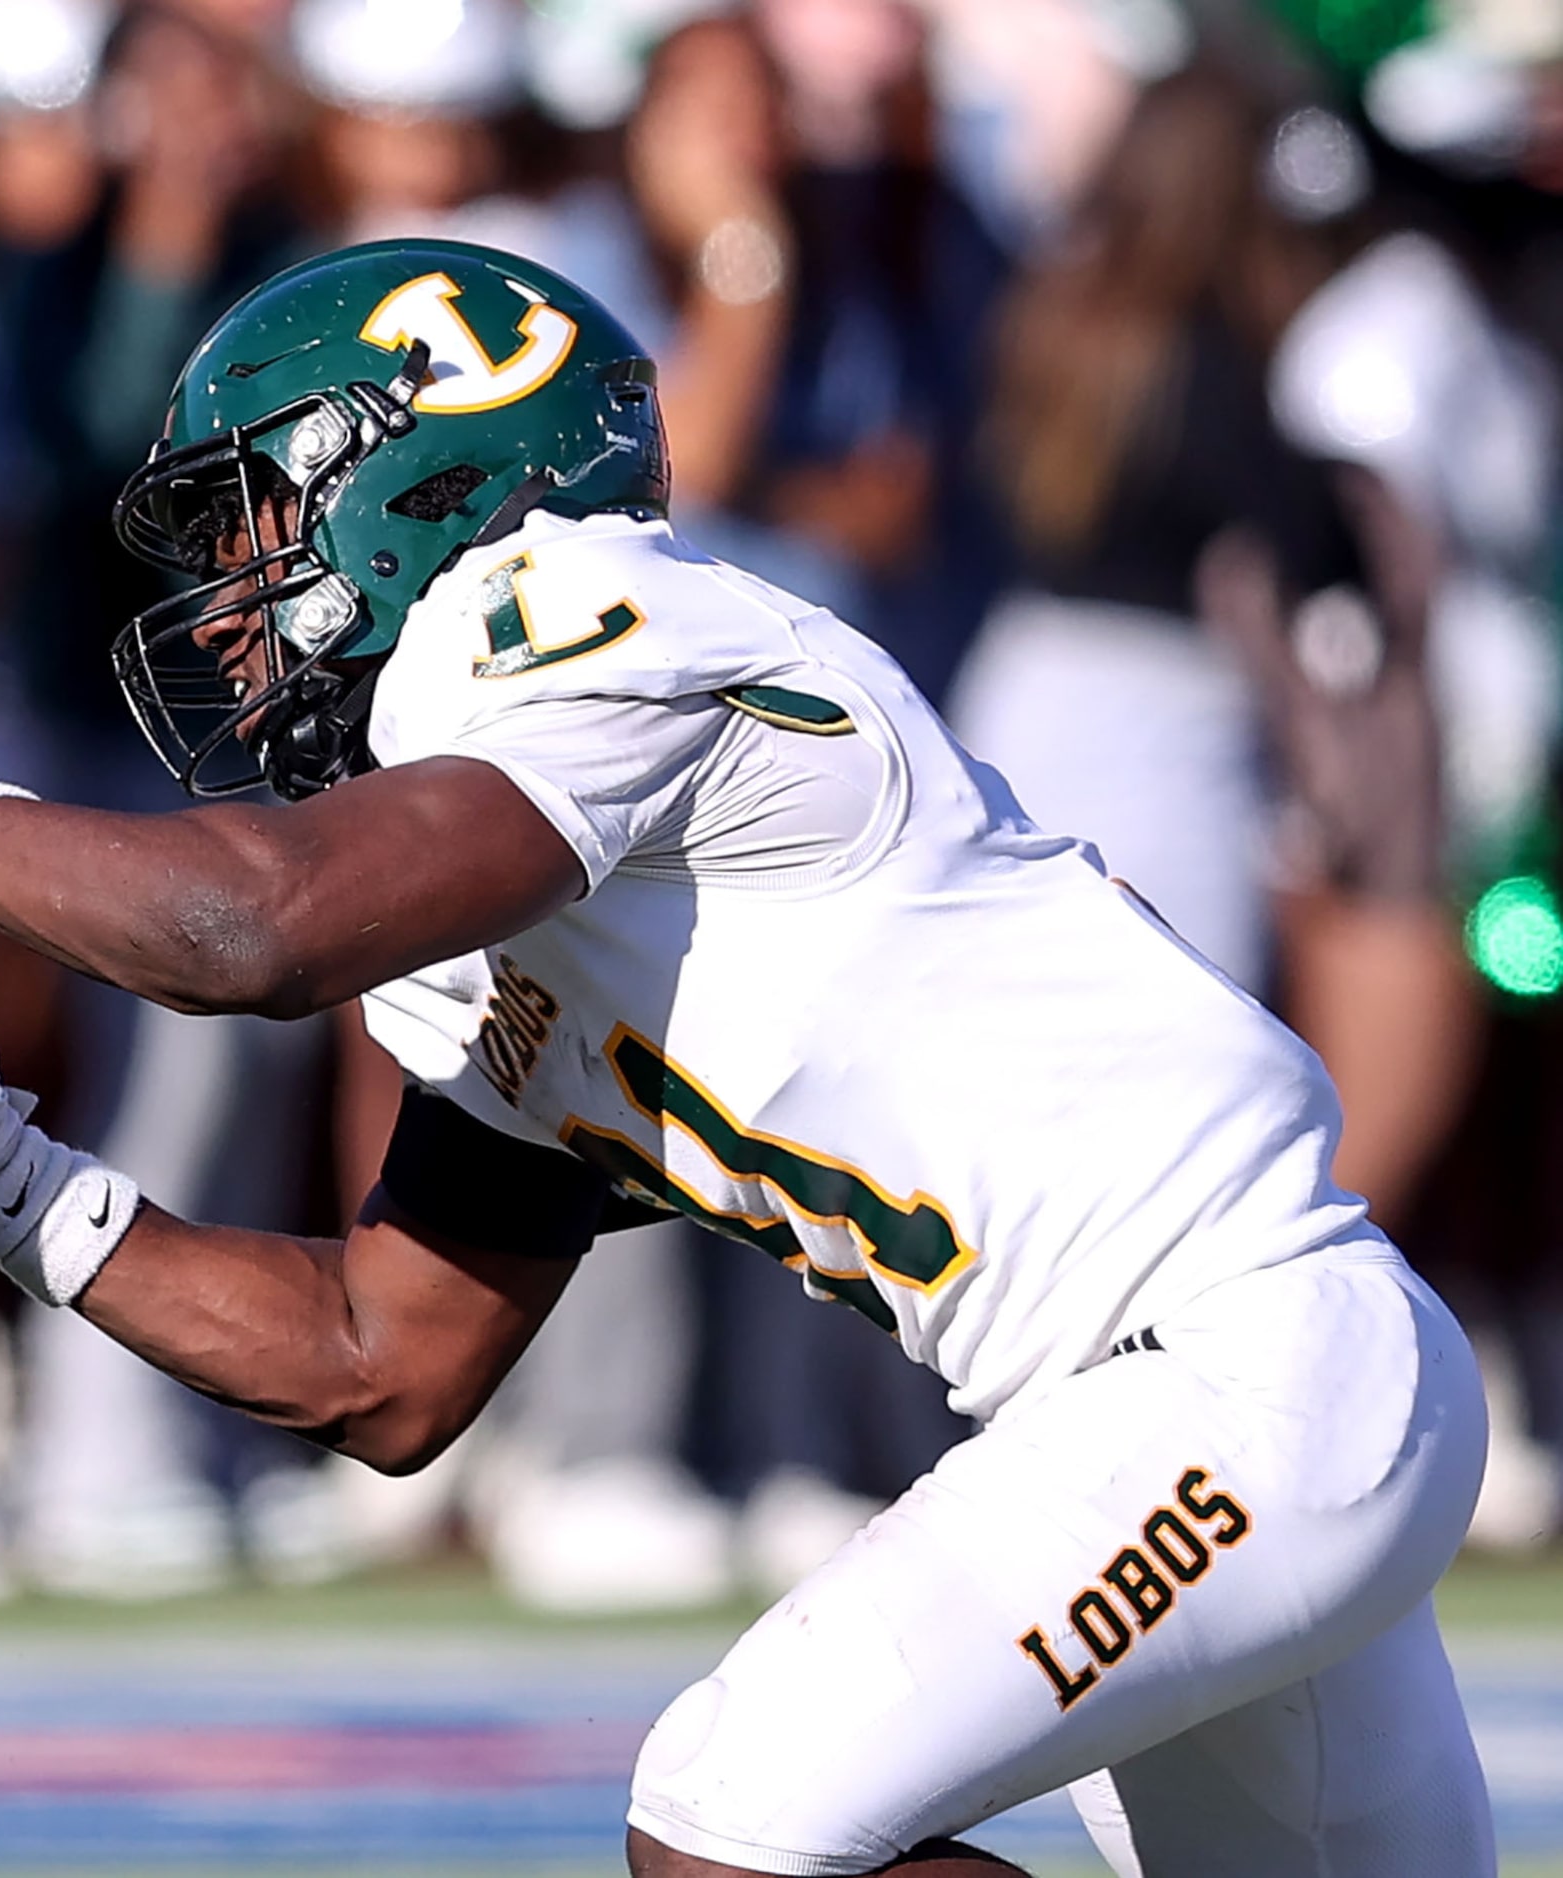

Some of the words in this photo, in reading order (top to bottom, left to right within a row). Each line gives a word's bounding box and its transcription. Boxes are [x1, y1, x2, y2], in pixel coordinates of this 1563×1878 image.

[358, 271, 579, 414] L
[472, 549, 648, 680] L
[1015, 1465, 1252, 1713] LOBOS
